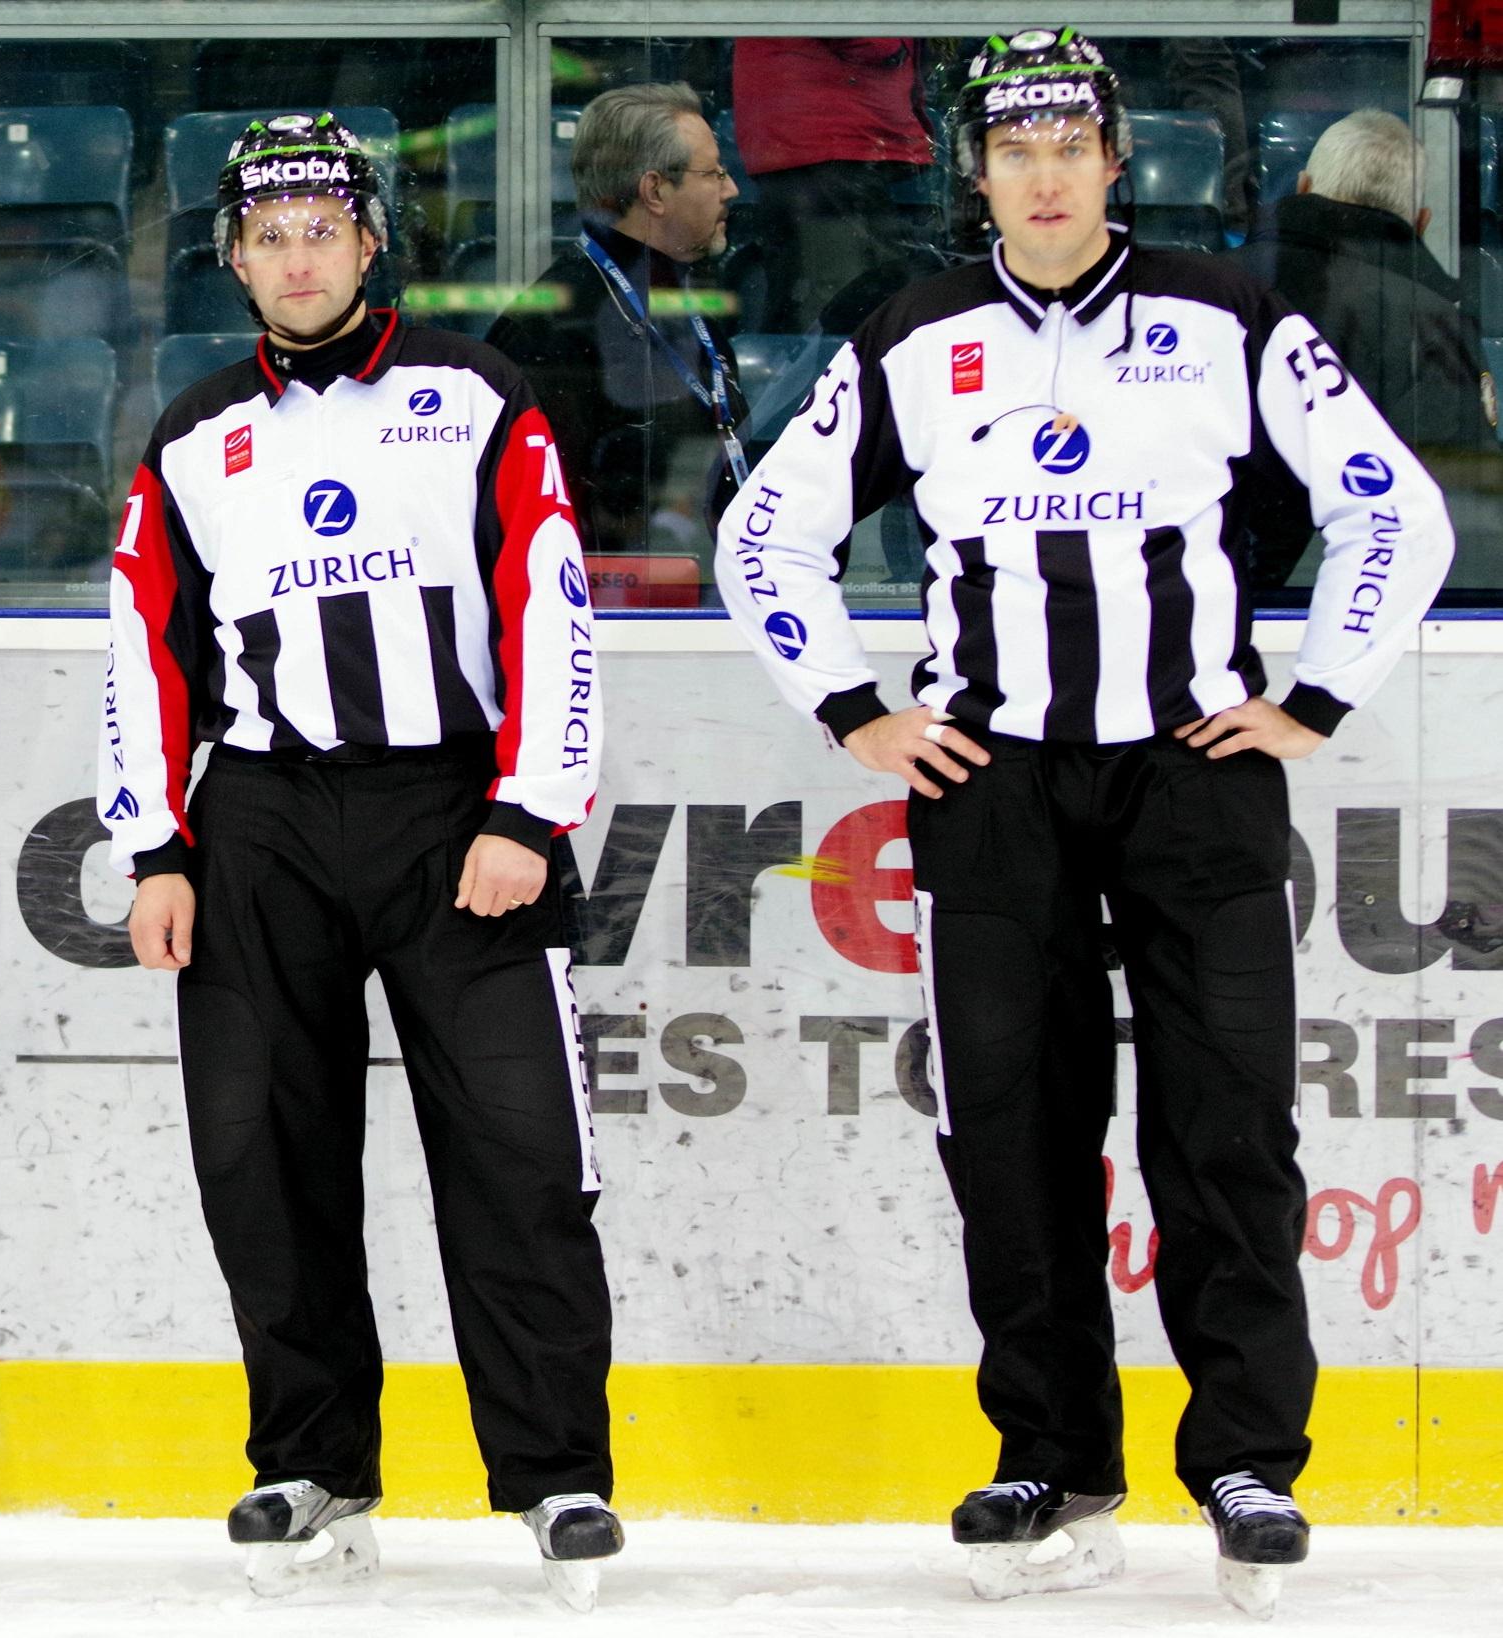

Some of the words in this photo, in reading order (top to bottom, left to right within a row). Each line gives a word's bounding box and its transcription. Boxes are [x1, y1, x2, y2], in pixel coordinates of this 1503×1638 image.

[1116, 364, 1205, 384] ZURICH
[380, 424, 471, 443] ZURICH
[114, 493, 145, 557] 1
[983, 491, 1143, 525] ZURICH
[268, 548, 416, 597] ZURICH
[1344, 506, 1402, 634] ZURICH
[562, 617, 594, 771] ZURICH
